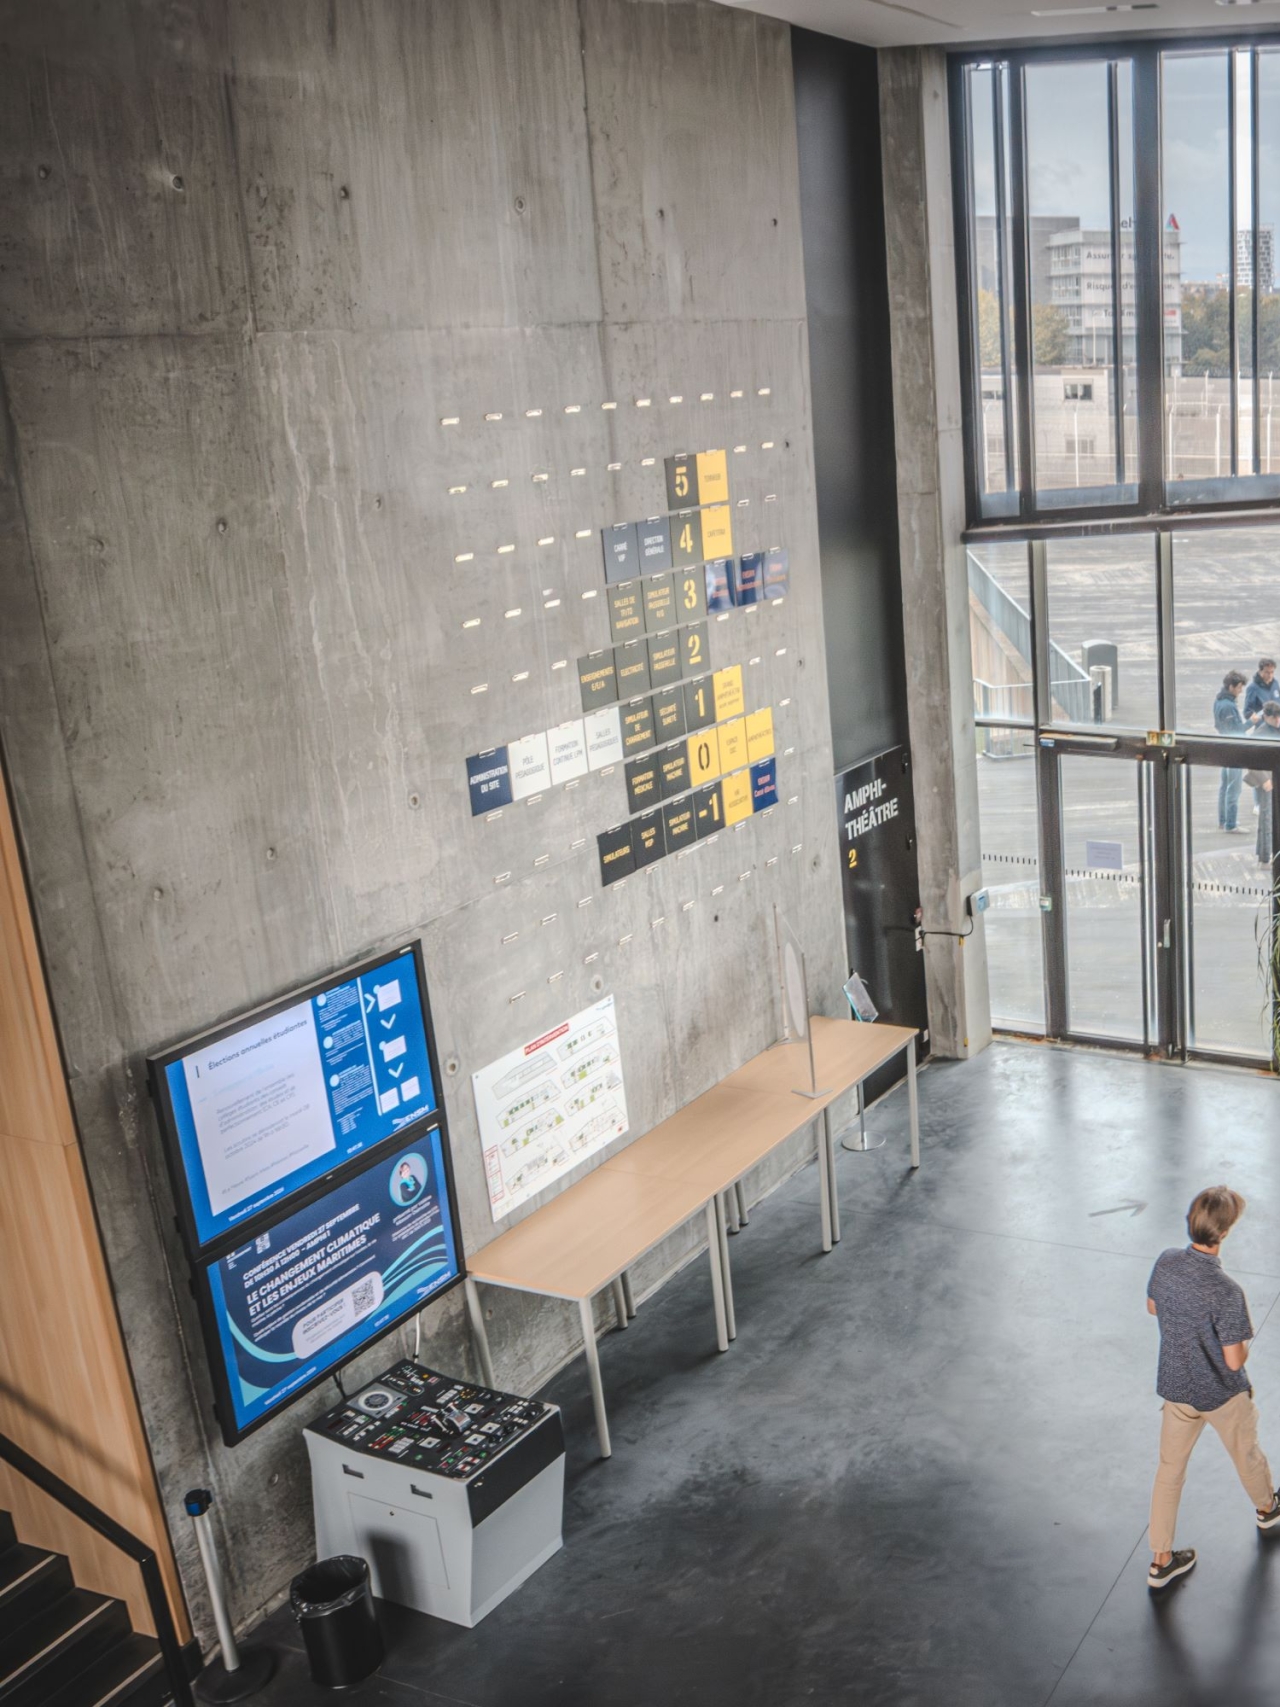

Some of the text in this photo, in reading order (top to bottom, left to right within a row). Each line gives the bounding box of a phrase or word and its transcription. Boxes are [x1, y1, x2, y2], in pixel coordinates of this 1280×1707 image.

[1086, 251, 1124, 260] Assurr
[675, 466, 689, 497] 5
[644, 534, 664, 546] DIRECTION
[680, 523, 693, 553] 4
[614, 541, 628, 552] CARRÉ
[645, 544, 664, 557] GÉNÉRALE
[647, 587, 670, 600] SIMULATEUR
[684, 579, 698, 610] 3
[614, 596, 636, 609] SALLES DE
[648, 597, 670, 610] PASSERELLE
[616, 616, 640, 629] NAVIGATION
[653, 647, 676, 661] SIMULATEUR
[688, 634, 702, 665] 2
[653, 657, 676, 671] PASSERELLE
[581, 666, 614, 683] ENSEIGNEMENTS
[694, 688, 705, 718] 1
[625, 710, 649, 725] SIMULATEUR
[595, 728, 611, 739] SALLES
[634, 723, 641, 732] DE
[625, 729, 652, 746] CHARGEMENT
[555, 740, 579, 753] FORMATION
[522, 755, 534, 765] PÔLE
[553, 752, 573, 766] CONTINUE
[663, 757, 685, 772] SIMULATEUR
[698, 742, 710, 771] 0
[470, 766, 508, 785] ADMINISTRATION
[632, 770, 654, 785] FORMATION
[666, 768, 683, 781] MACHINE
[481, 780, 500, 794] DU SITE
[844, 778, 888, 814] AMPHI-
[699, 792, 720, 822] -1
[669, 811, 691, 827] SIMULATEUR
[845, 798, 898, 841] THÉÂTRE
[641, 827, 656, 839] SALLES
[672, 822, 689, 835] MACHINE
[603, 845, 631, 864] SIMULATEURS
[848, 849, 858, 869] 2
[207, 1018, 307, 1071] Élections annuelles étudiantes
[405, 1104, 429, 1123] ENSM
[242, 1247, 286, 1281] CONFÉRENCE
[285, 1228, 317, 1254] VENDREDI
[317, 1223, 325, 1235] 27
[324, 1202, 360, 1230] SEPTEMBRE
[244, 1277, 253, 1289] DE
[305, 1231, 326, 1250] AMPHI
[246, 1289, 258, 1305] LE
[258, 1247, 325, 1297] CHANGEMENT
[326, 1211, 380, 1255] CLIMATIQUE
[248, 1299, 262, 1317] ET
[261, 1288, 279, 1308] LES
[279, 1265, 316, 1297] ENJEUX
[316, 1232, 367, 1273] MARITIMES
[427, 1271, 451, 1291] ENSM
[302, 1316, 316, 1329] POUR
[316, 1297, 343, 1320] PARTICIPER
